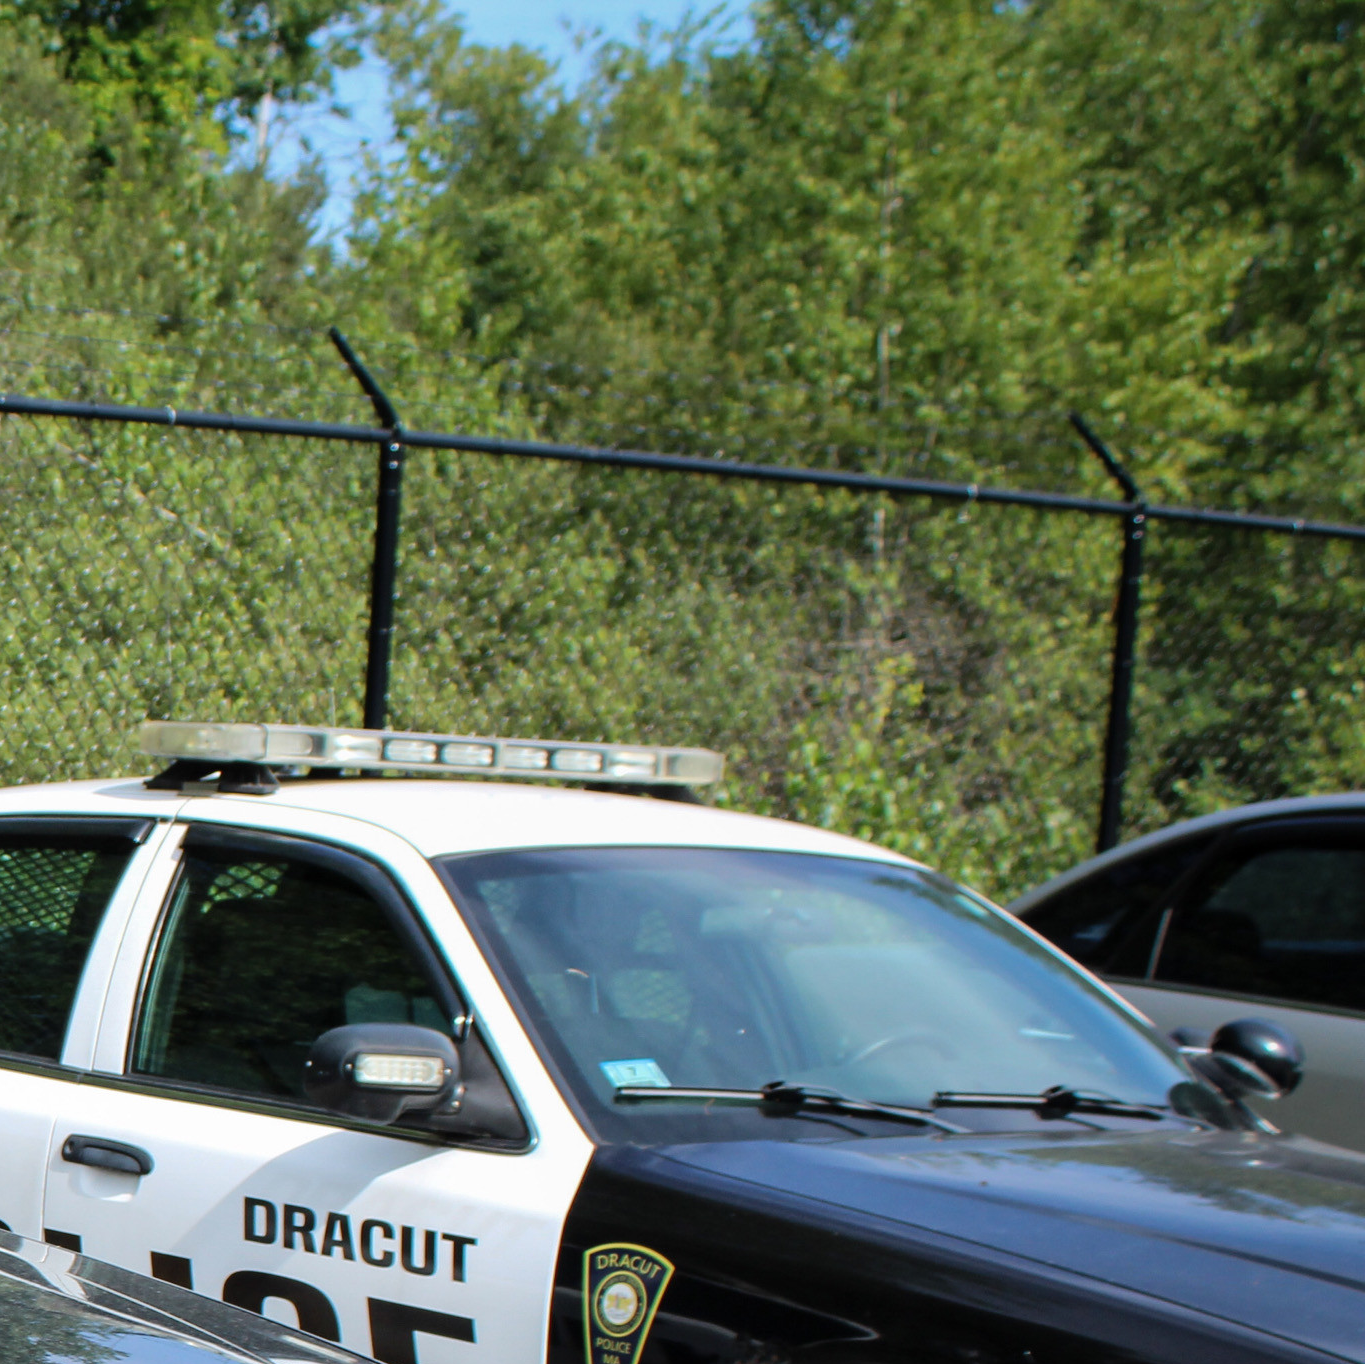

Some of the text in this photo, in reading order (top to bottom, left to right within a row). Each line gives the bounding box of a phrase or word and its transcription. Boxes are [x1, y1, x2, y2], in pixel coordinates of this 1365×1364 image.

[243, 1195, 478, 1283] DRACUT
[595, 1252, 663, 1279] DRACUT
[595, 1337, 632, 1355] POLICE
